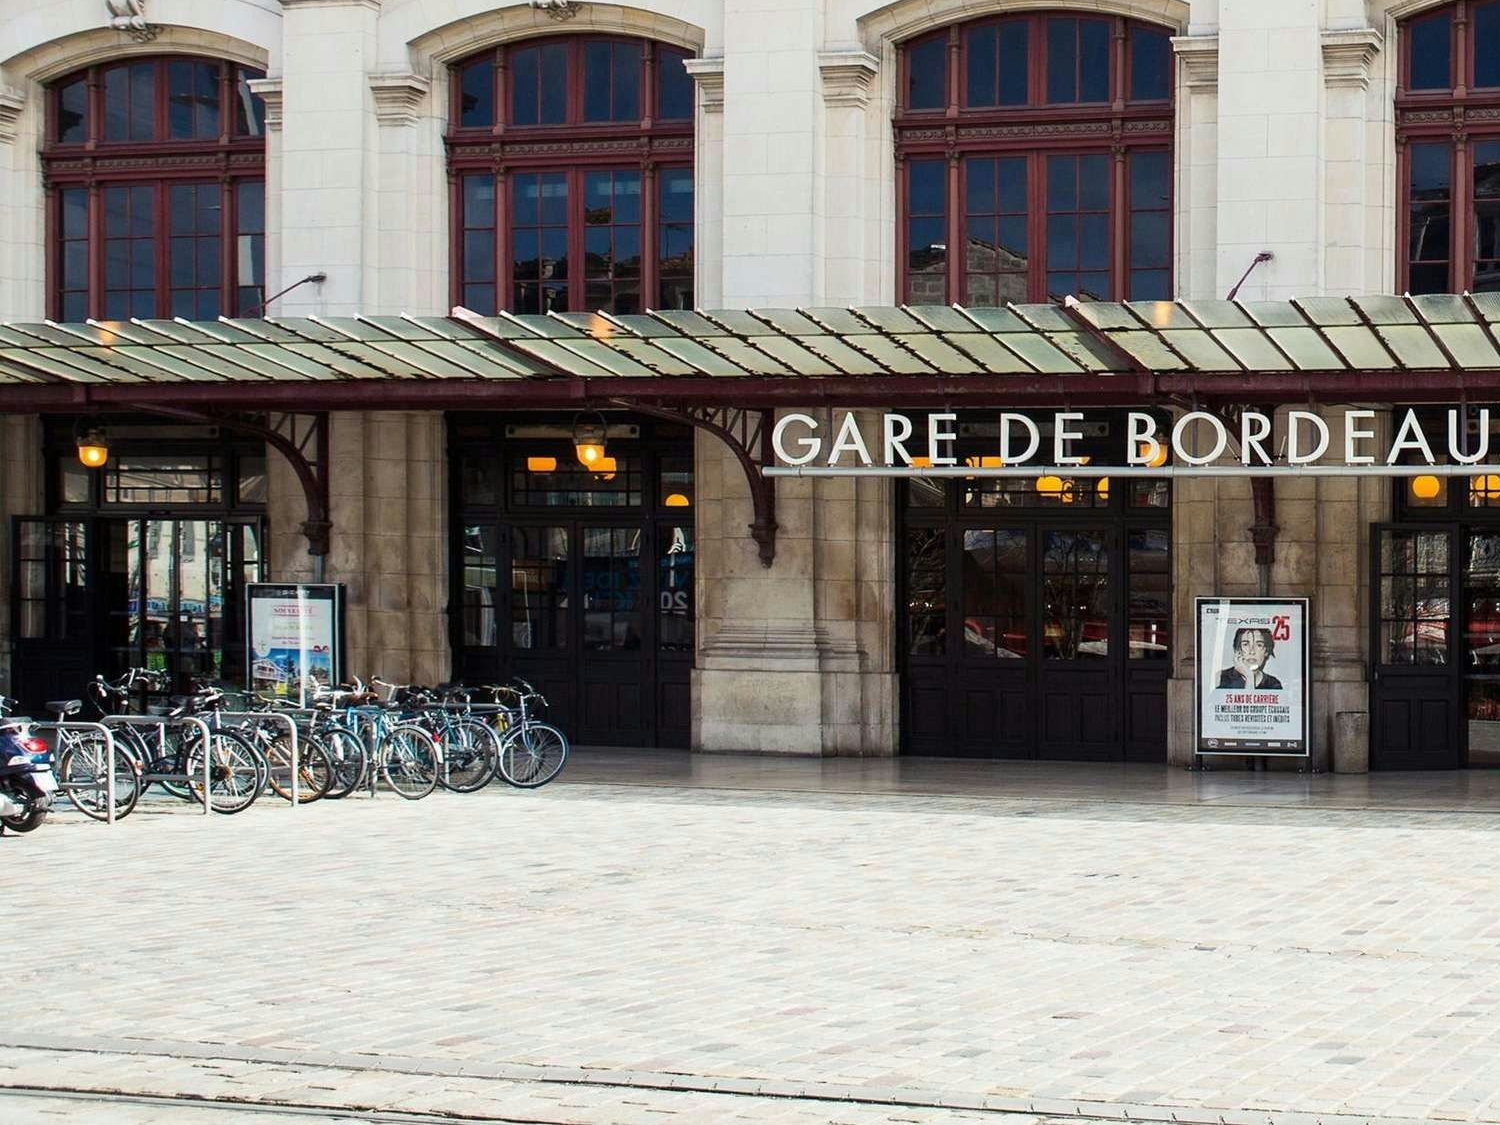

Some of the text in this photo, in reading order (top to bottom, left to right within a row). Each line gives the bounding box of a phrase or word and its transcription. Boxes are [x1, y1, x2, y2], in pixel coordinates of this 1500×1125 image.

[772, 412, 957, 465] GARE
[1001, 412, 1085, 464] DE
[1272, 615, 1290, 641] 25
[1225, 694, 1233, 704] 25
[1234, 694, 1245, 704] ANS
[1245, 694, 1252, 704] DE
